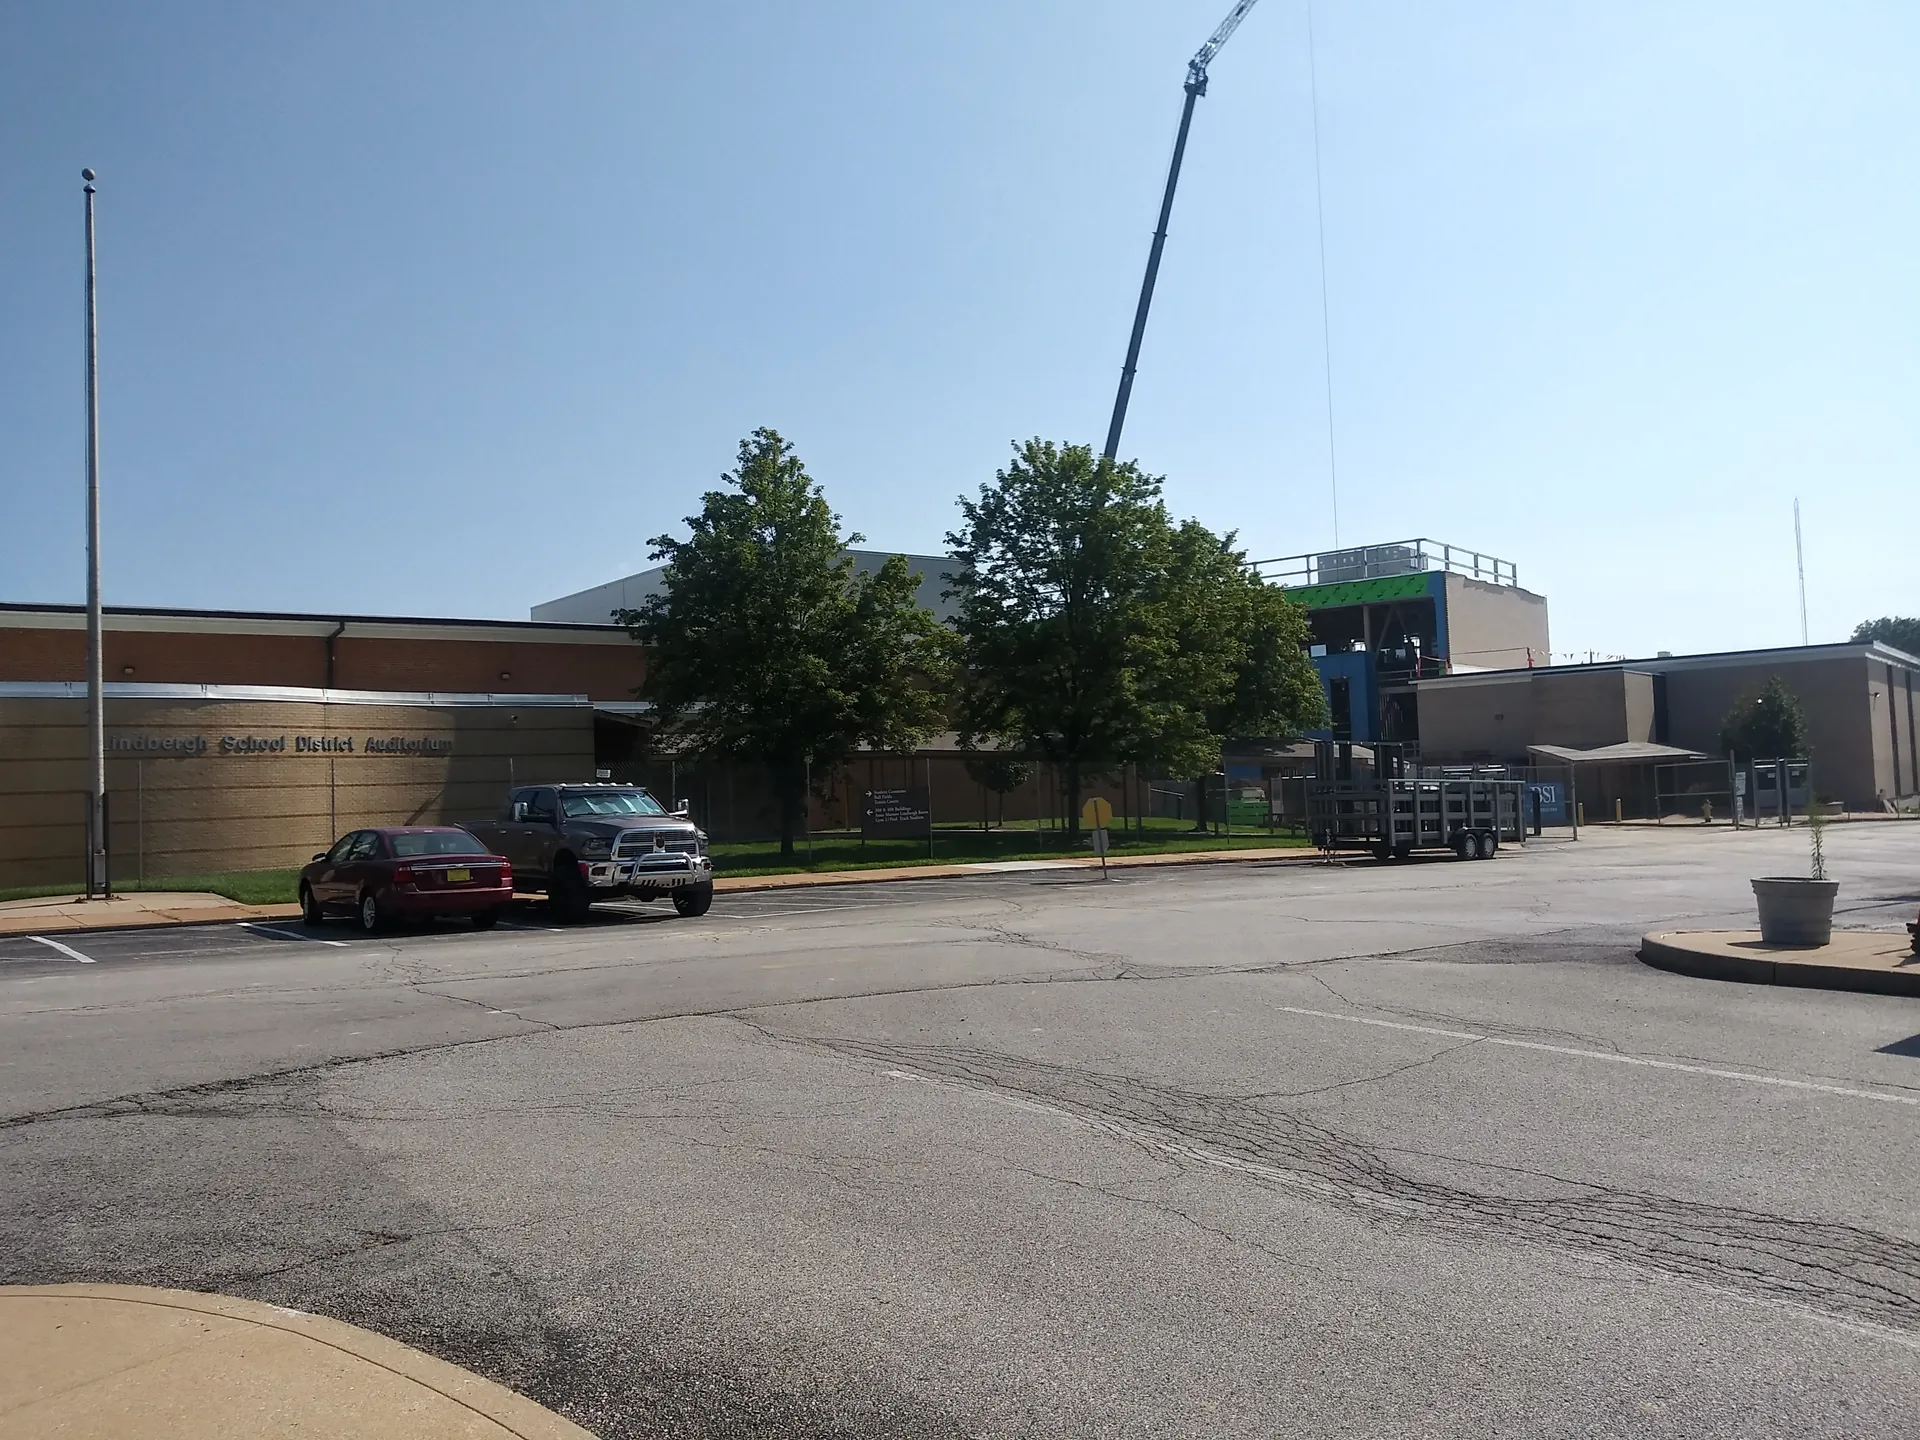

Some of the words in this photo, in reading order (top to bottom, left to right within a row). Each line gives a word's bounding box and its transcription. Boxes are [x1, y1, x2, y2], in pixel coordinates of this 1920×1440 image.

[222, 735, 286, 751] School
[297, 736, 354, 752] District
[366, 737, 453, 752] Auditorium
